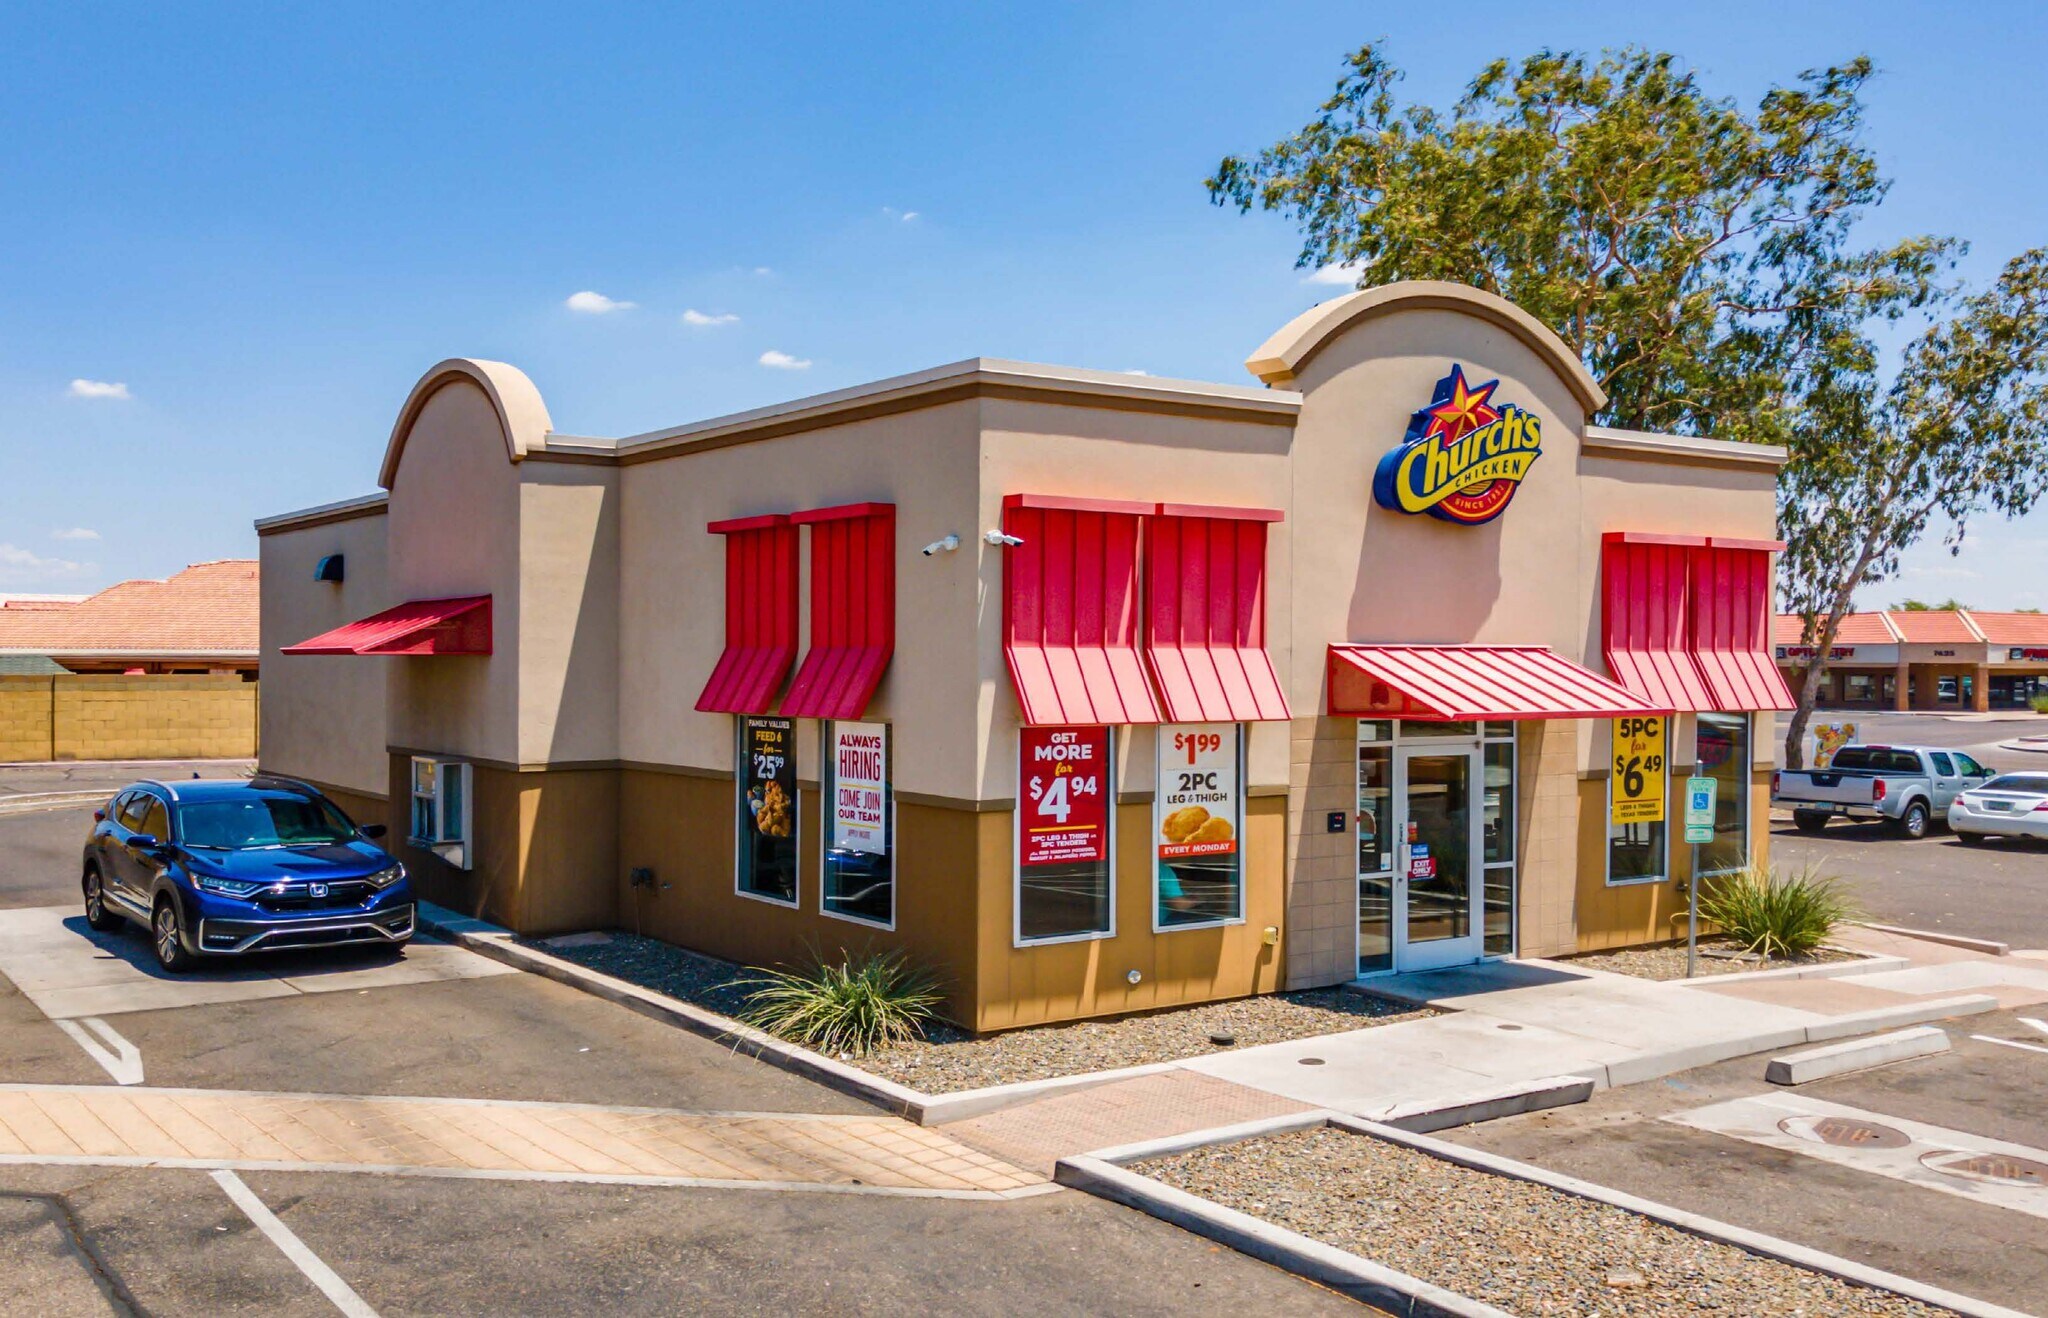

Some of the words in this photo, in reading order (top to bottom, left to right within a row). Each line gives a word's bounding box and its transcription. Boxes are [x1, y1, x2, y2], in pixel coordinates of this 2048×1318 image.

[1396, 407, 1541, 513] Church's
[1455, 459, 1521, 488] CHICKEN
[1455, 497, 1485, 509] SINCE
[748, 719, 768, 728] FAMILY
[769, 720, 790, 729] VALUES
[1620, 718, 1658, 738] 5PC
[755, 731, 776, 741] FEED
[777, 732, 782, 742] 6
[840, 734, 881, 749] ALWAYS
[1051, 732, 1077, 743] GET
[763, 743, 774, 754] for
[1034, 744, 1092, 761] MORE
[840, 750, 880, 781] HIRING
[1055, 761, 1073, 776] for
[1178, 772, 1217, 791] 2PC
[839, 789, 860, 808] COME
[863, 791, 880, 810] JOIN
[1167, 795, 1185, 804] LEG
[1195, 793, 1227, 803] THIGH
[838, 809, 855, 820] OUR
[858, 811, 880, 823] TEAM
[1164, 845, 1190, 855] EVERY
[1192, 843, 1230, 853] MONDAY
[1412, 866, 1431, 874] ONLY
[1414, 859, 1430, 867] EXIT
